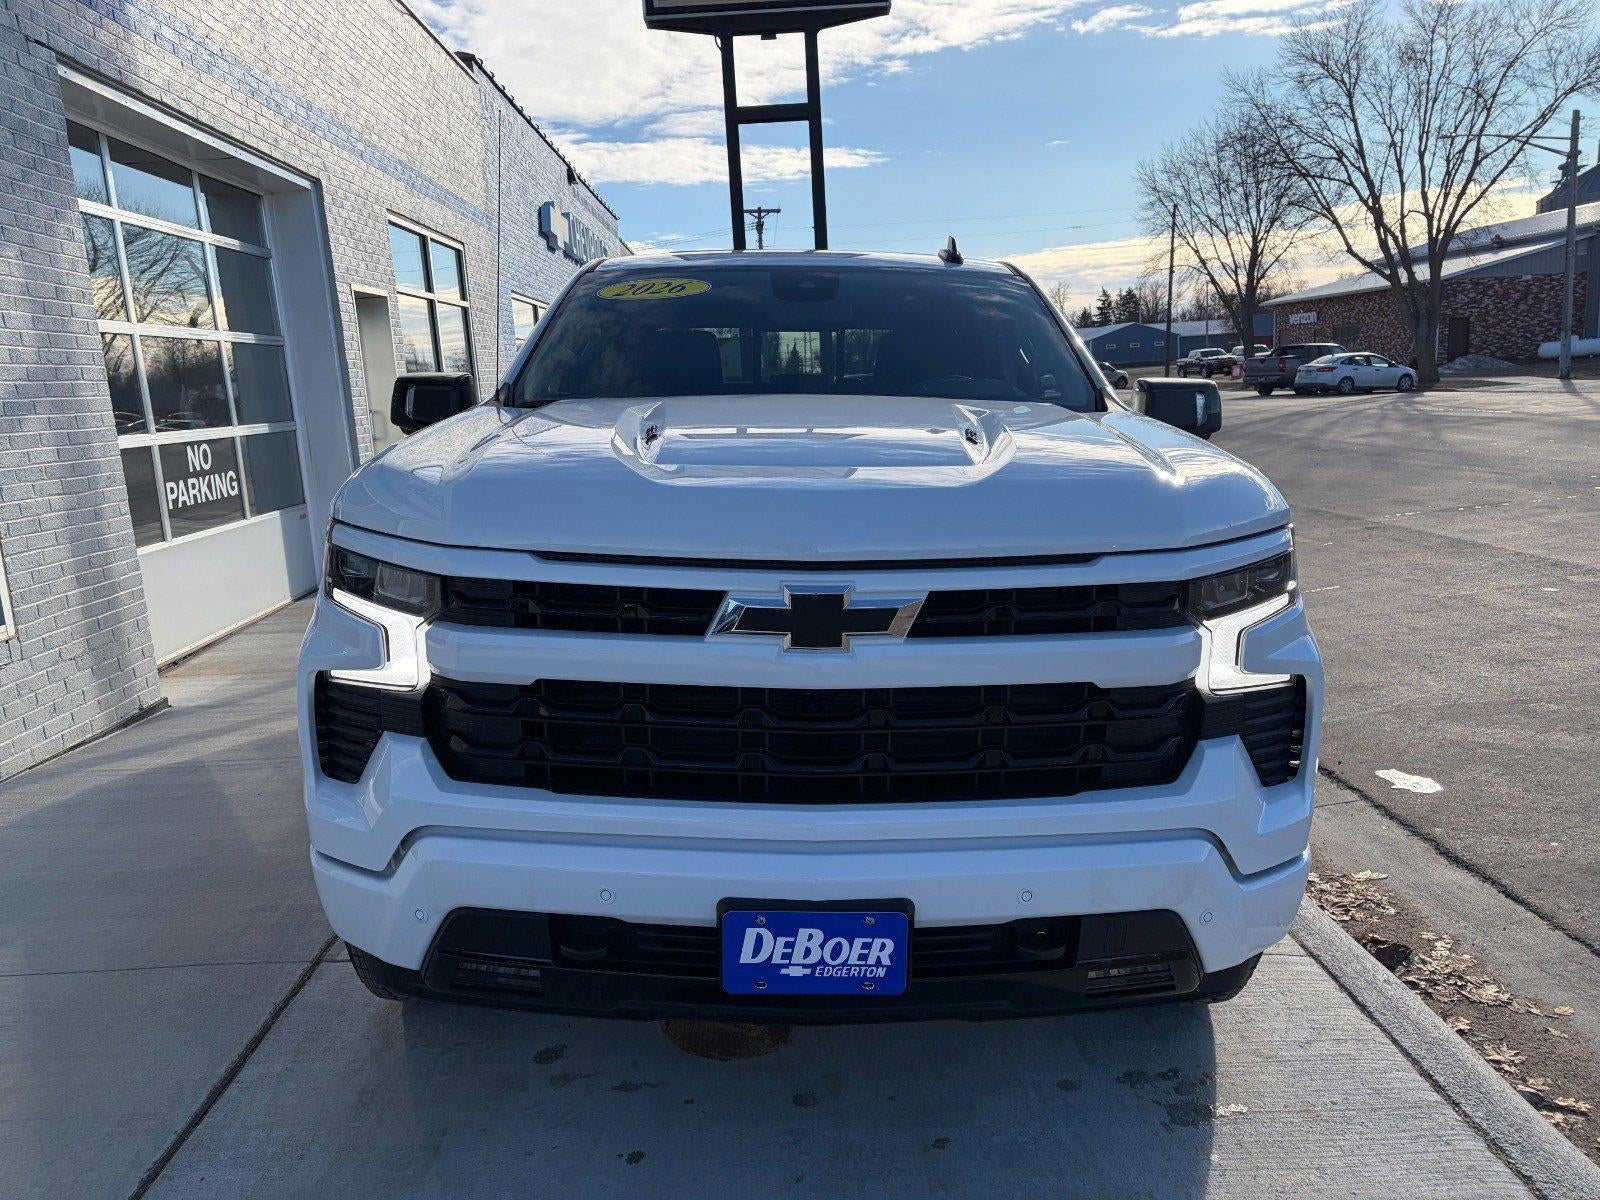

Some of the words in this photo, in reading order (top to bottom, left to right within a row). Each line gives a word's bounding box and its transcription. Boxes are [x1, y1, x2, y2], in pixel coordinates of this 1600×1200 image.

[611, 281, 687, 297] 2026
[1289, 311, 1318, 325] verizon
[186, 443, 212, 473] NO
[165, 470, 239, 510] PARKING
[739, 927, 895, 966] DEBOER
[814, 965, 888, 979] EDGERTON
